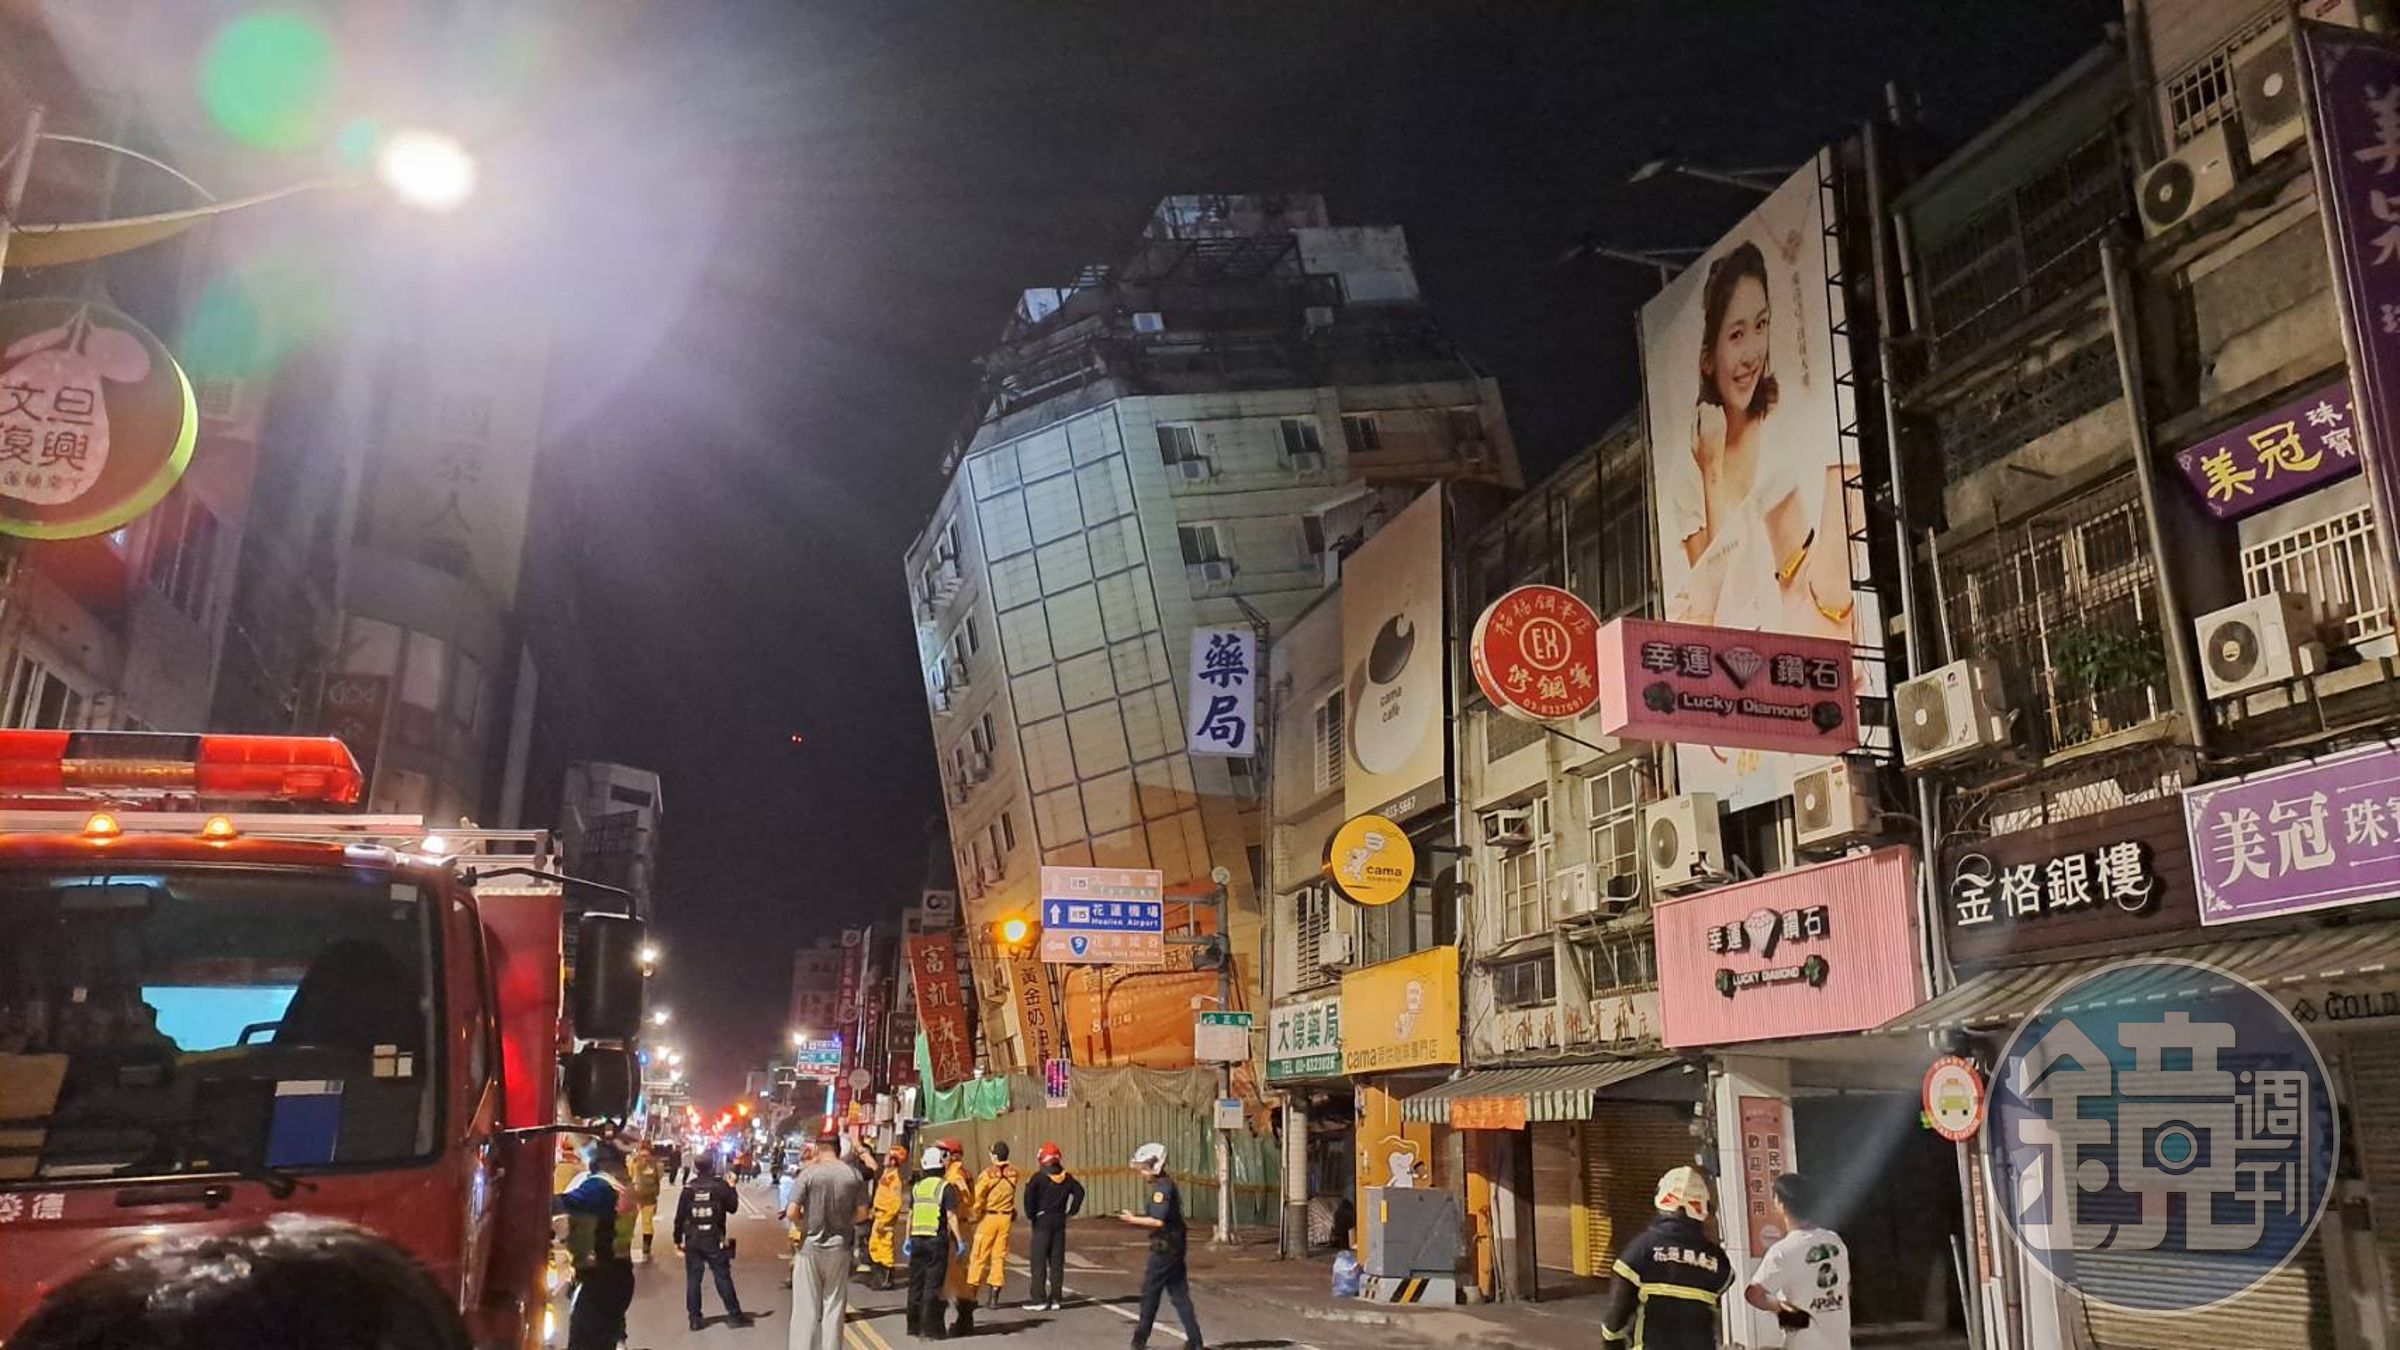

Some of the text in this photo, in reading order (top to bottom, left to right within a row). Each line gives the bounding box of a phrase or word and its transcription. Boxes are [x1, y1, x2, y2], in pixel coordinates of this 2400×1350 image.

[0, 381, 95, 426] 文旦
[2200, 401, 2356, 501] 美冠 珠寶
[1643, 641, 1841, 690] 幸運 鑽石
[1196, 632, 1250, 749] 藥局
[1682, 692, 1810, 718] Lucky Diamond
[2210, 791, 2400, 888] 美冠 珠
[1366, 864, 1403, 877] cama
[1951, 841, 2153, 926] 金格銀樓
[1127, 918, 1159, 928] Airport
[1707, 906, 1822, 951] 幸運 鑽石
[1732, 966, 1800, 986] LUCKY DIAMOND
[1346, 1047, 1377, 1069] cama
